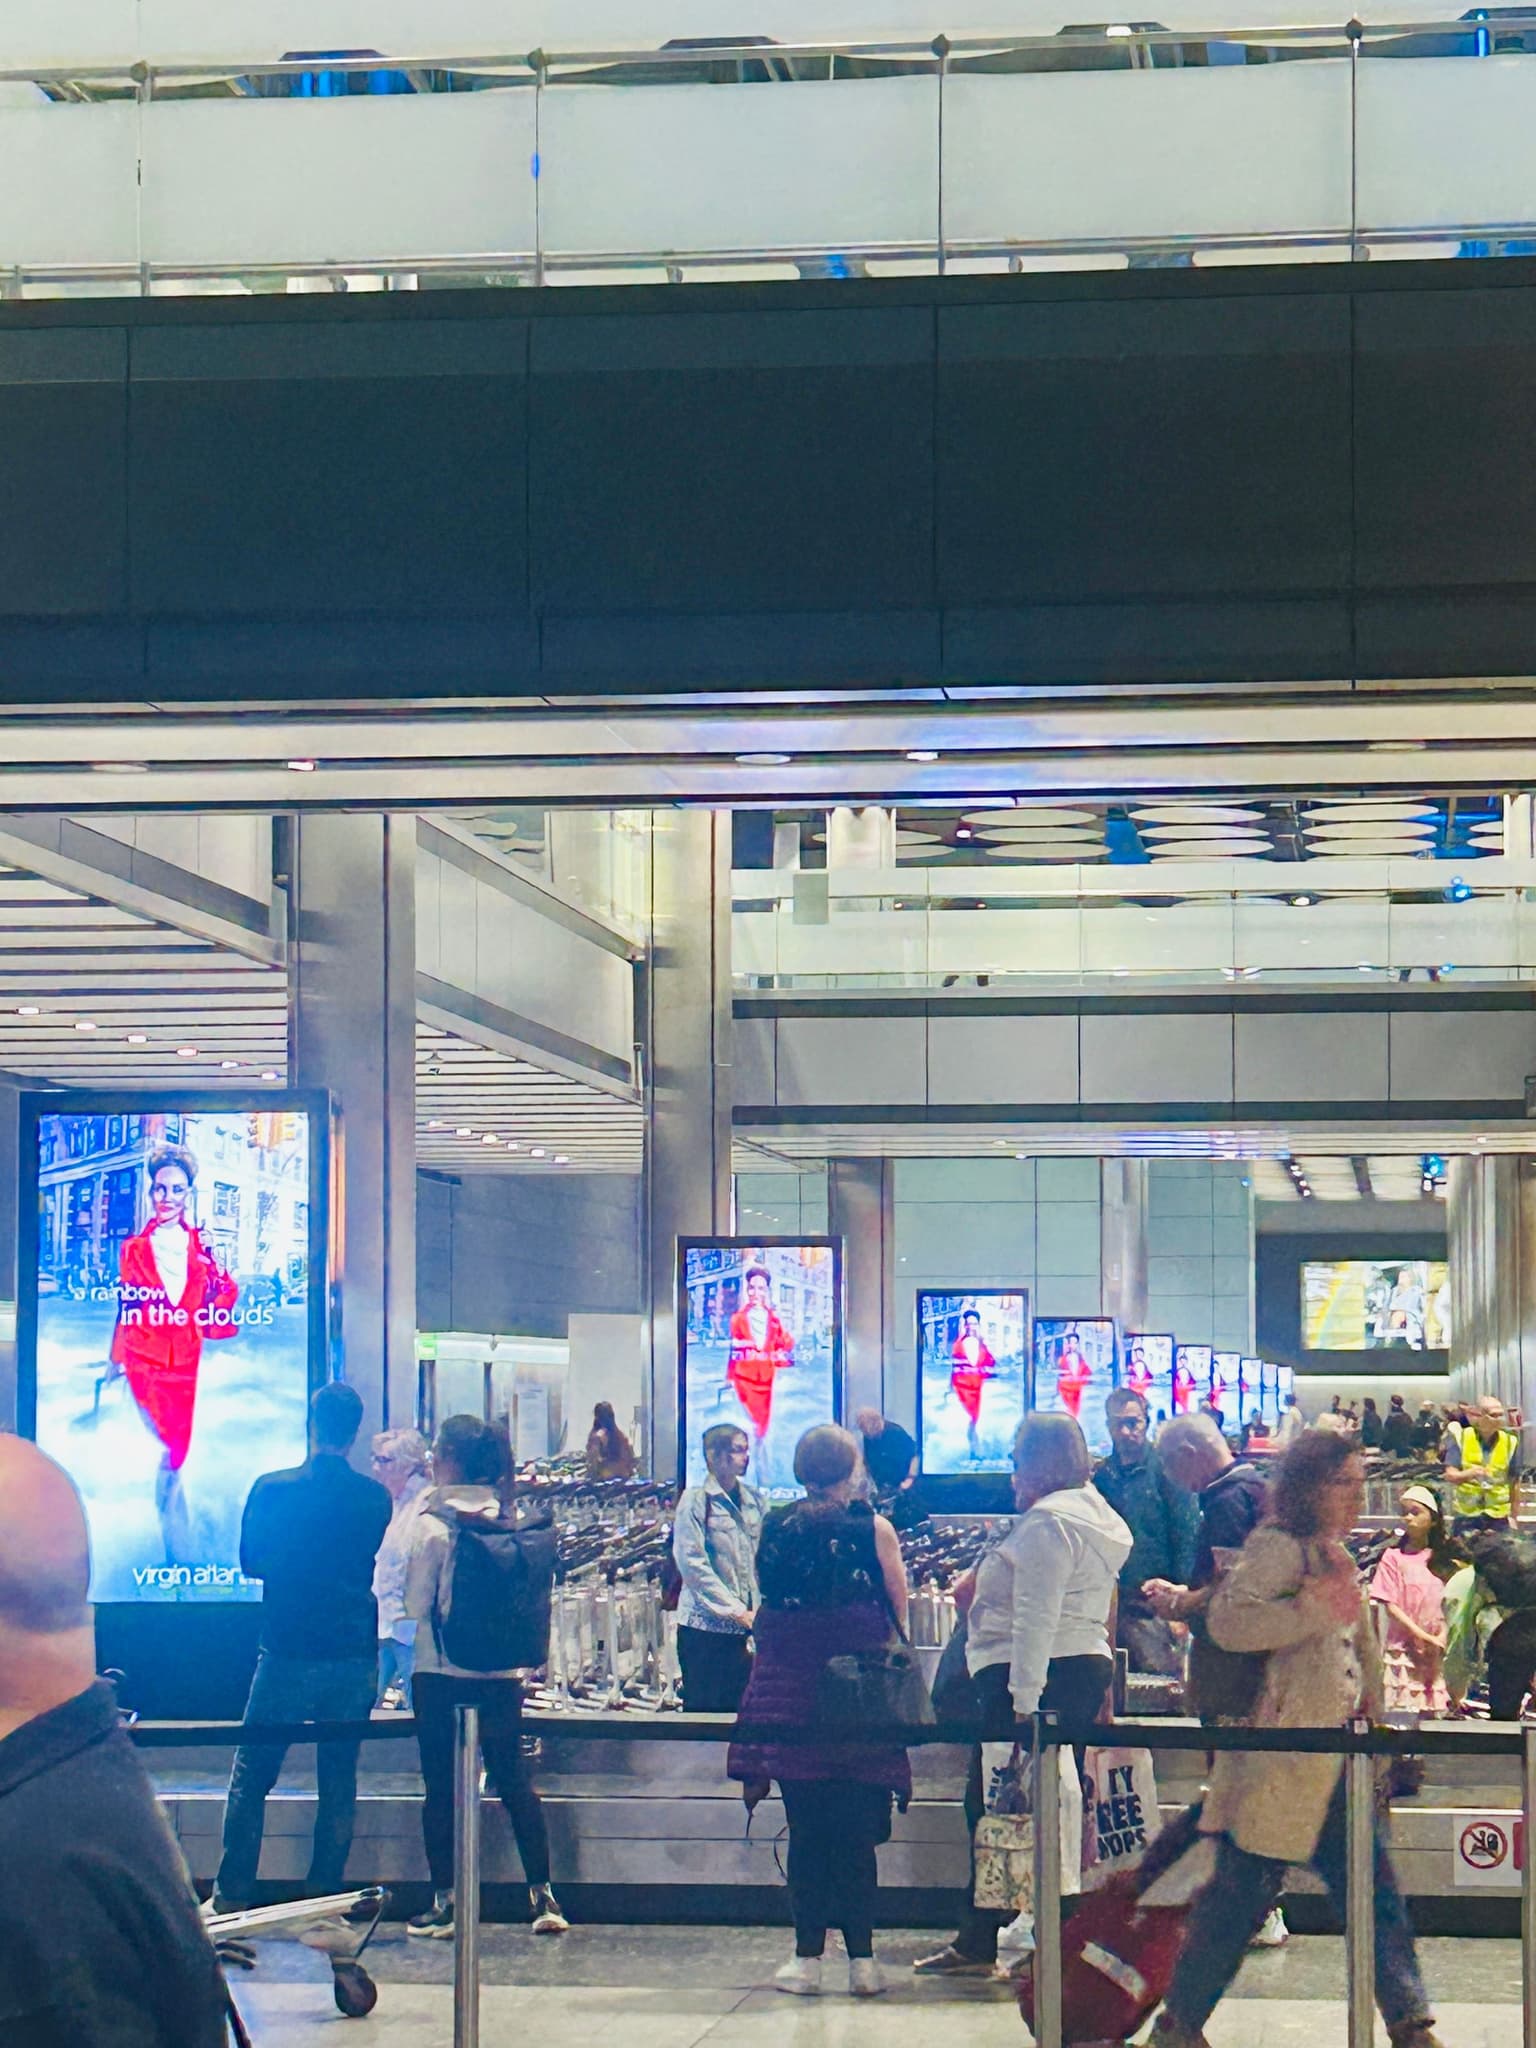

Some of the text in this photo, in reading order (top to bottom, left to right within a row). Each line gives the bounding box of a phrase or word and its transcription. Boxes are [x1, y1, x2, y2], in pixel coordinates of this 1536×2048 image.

[91, 1281, 166, 1301] rainbow
[120, 1303, 274, 1326] in the clouds
[132, 1563, 264, 1590] virgin atlan
